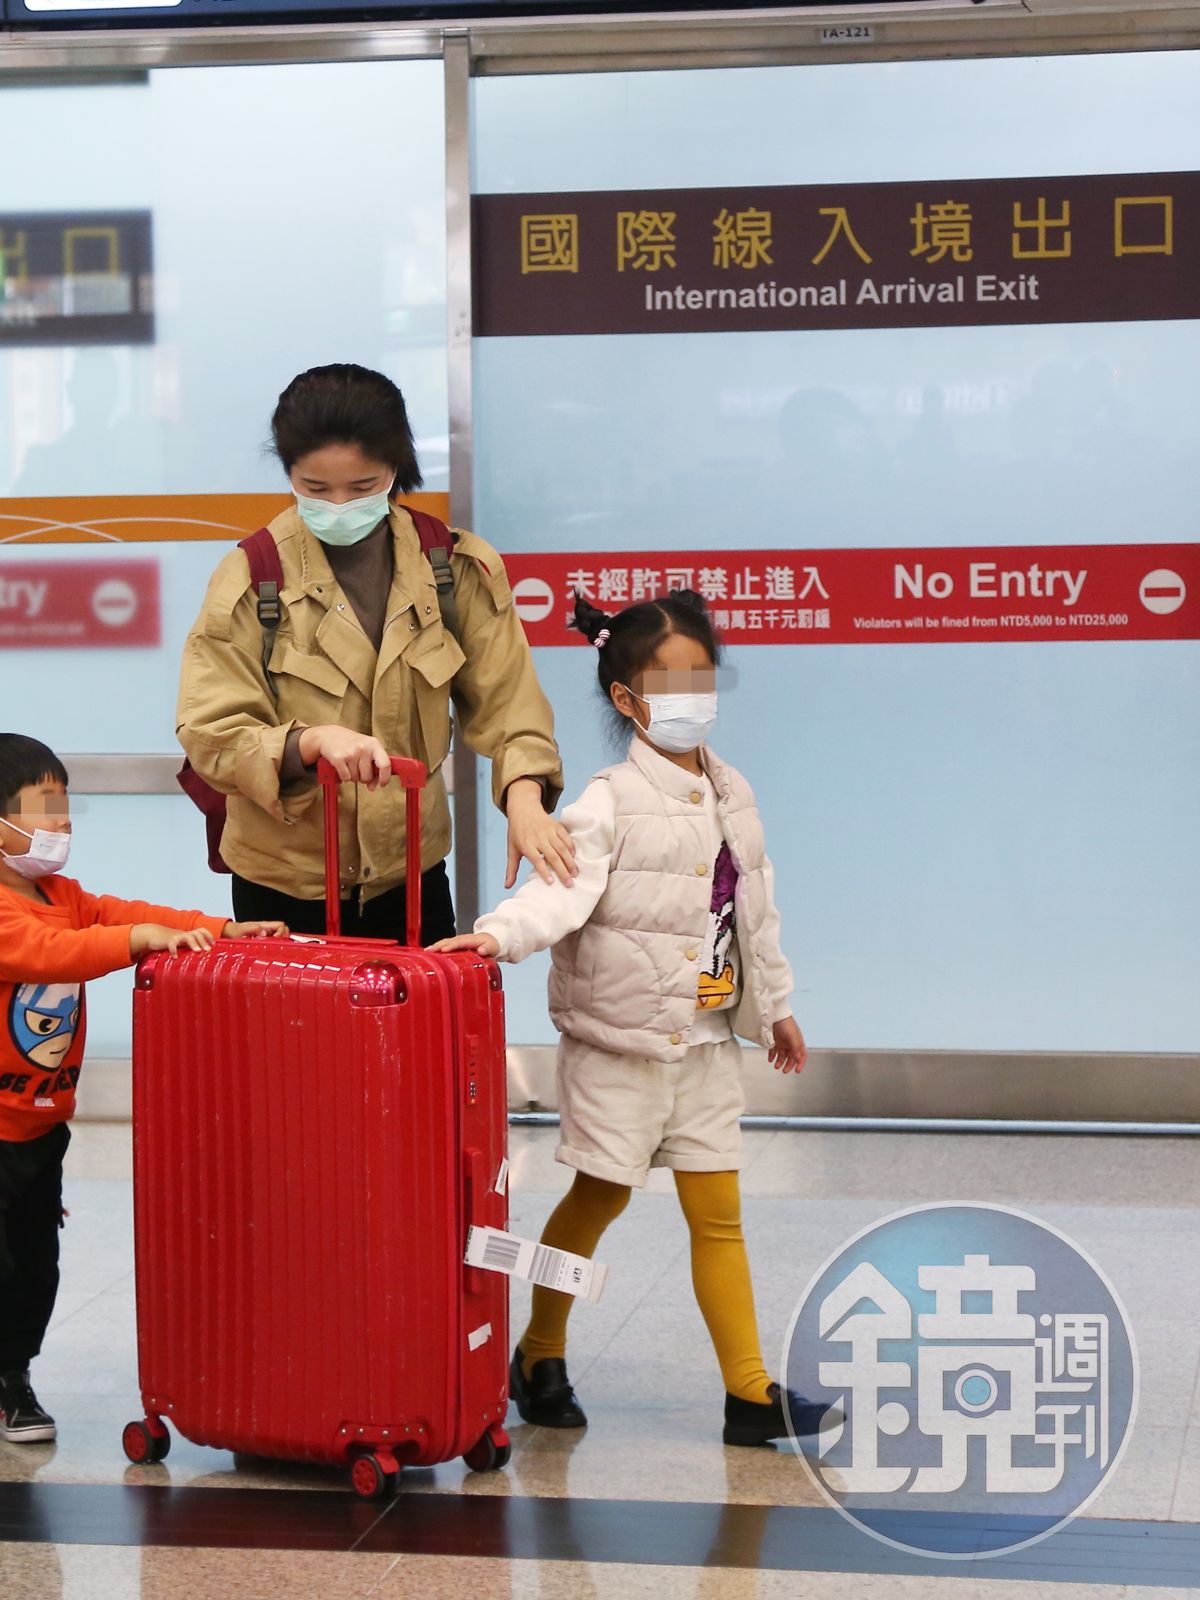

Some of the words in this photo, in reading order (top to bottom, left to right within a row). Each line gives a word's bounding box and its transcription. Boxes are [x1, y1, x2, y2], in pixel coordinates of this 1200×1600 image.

[520, 194, 1174, 275] 國際線入境出口
[644, 279, 846, 310] International
[856, 276, 965, 305] Arrival
[975, 274, 1040, 302] Exit
[565, 566, 830, 602] 未經許可禁止進入
[894, 563, 954, 600] No
[970, 562, 1088, 607] Entry
[853, 617, 902, 629] Violators
[905, 617, 923, 628] will
[926, 617, 939, 628] be
[942, 615, 970, 627] fined
[972, 615, 997, 627] from
[1000, 614, 1052, 628] NTD5,000
[1055, 615, 1066, 626] to
[1069, 613, 1128, 627] NTD25,000
